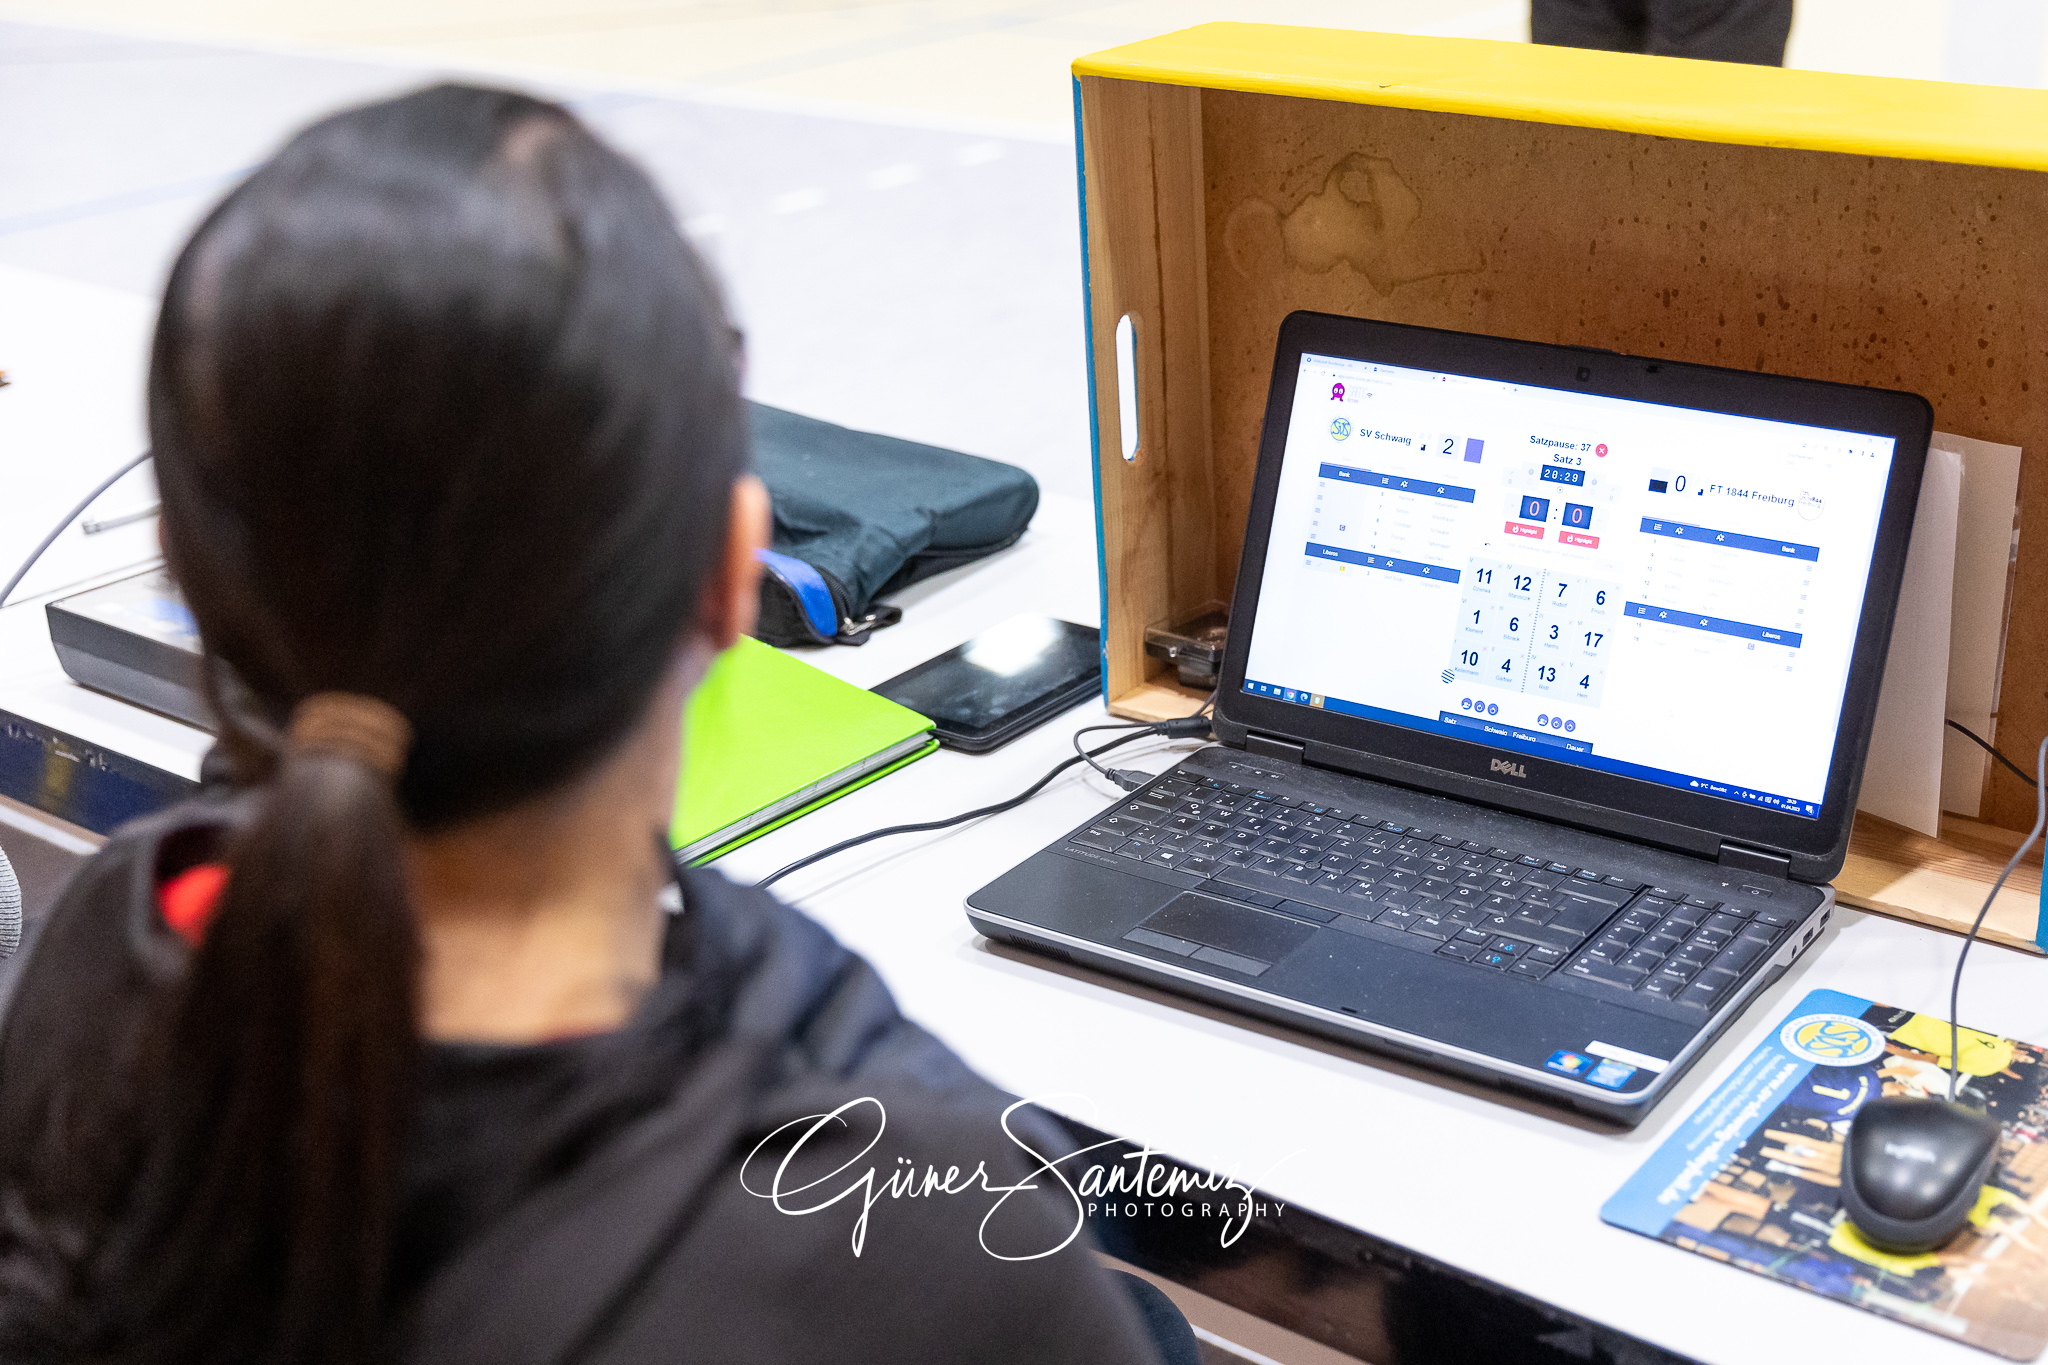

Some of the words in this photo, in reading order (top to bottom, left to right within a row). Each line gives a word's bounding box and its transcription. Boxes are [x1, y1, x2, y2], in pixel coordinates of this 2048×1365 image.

[1360, 429, 1372, 438] SV
[1374, 431, 1412, 446] Schwaig
[1530, 435, 1577, 450] Satzpause:
[1580, 443, 1592, 452] 37
[1442, 438, 1454, 455] 2
[1553, 454, 1574, 465] Satz
[1575, 457, 1582, 466] 3
[1675, 475, 1687, 492] 0
[1709, 484, 1724, 494] FT
[1726, 487, 1749, 498] 1844
[1752, 492, 1795, 508] Freiburg
[1529, 501, 1540, 517] 0
[1572, 508, 1583, 524] 0
[1520, 527, 1538, 535] Highlight
[1574, 537, 1593, 545] Highlight
[1476, 568, 1492, 584] 11
[1513, 574, 1532, 592] 12
[1558, 582, 1568, 597] 7
[1595, 590, 1606, 606] 6
[1473, 609, 1481, 625] 1
[1509, 617, 1519, 632] 6
[1549, 624, 1559, 640] 3
[1584, 631, 1603, 648] 17
[1461, 649, 1479, 666] 10
[1501, 659, 1511, 673] 4
[1538, 665, 1556, 682] 13
[1579, 674, 1590, 689] 4
[1444, 717, 1457, 725] Satz
[1566, 744, 1584, 752] Dauer
[1490, 758, 1527, 778] DELL
